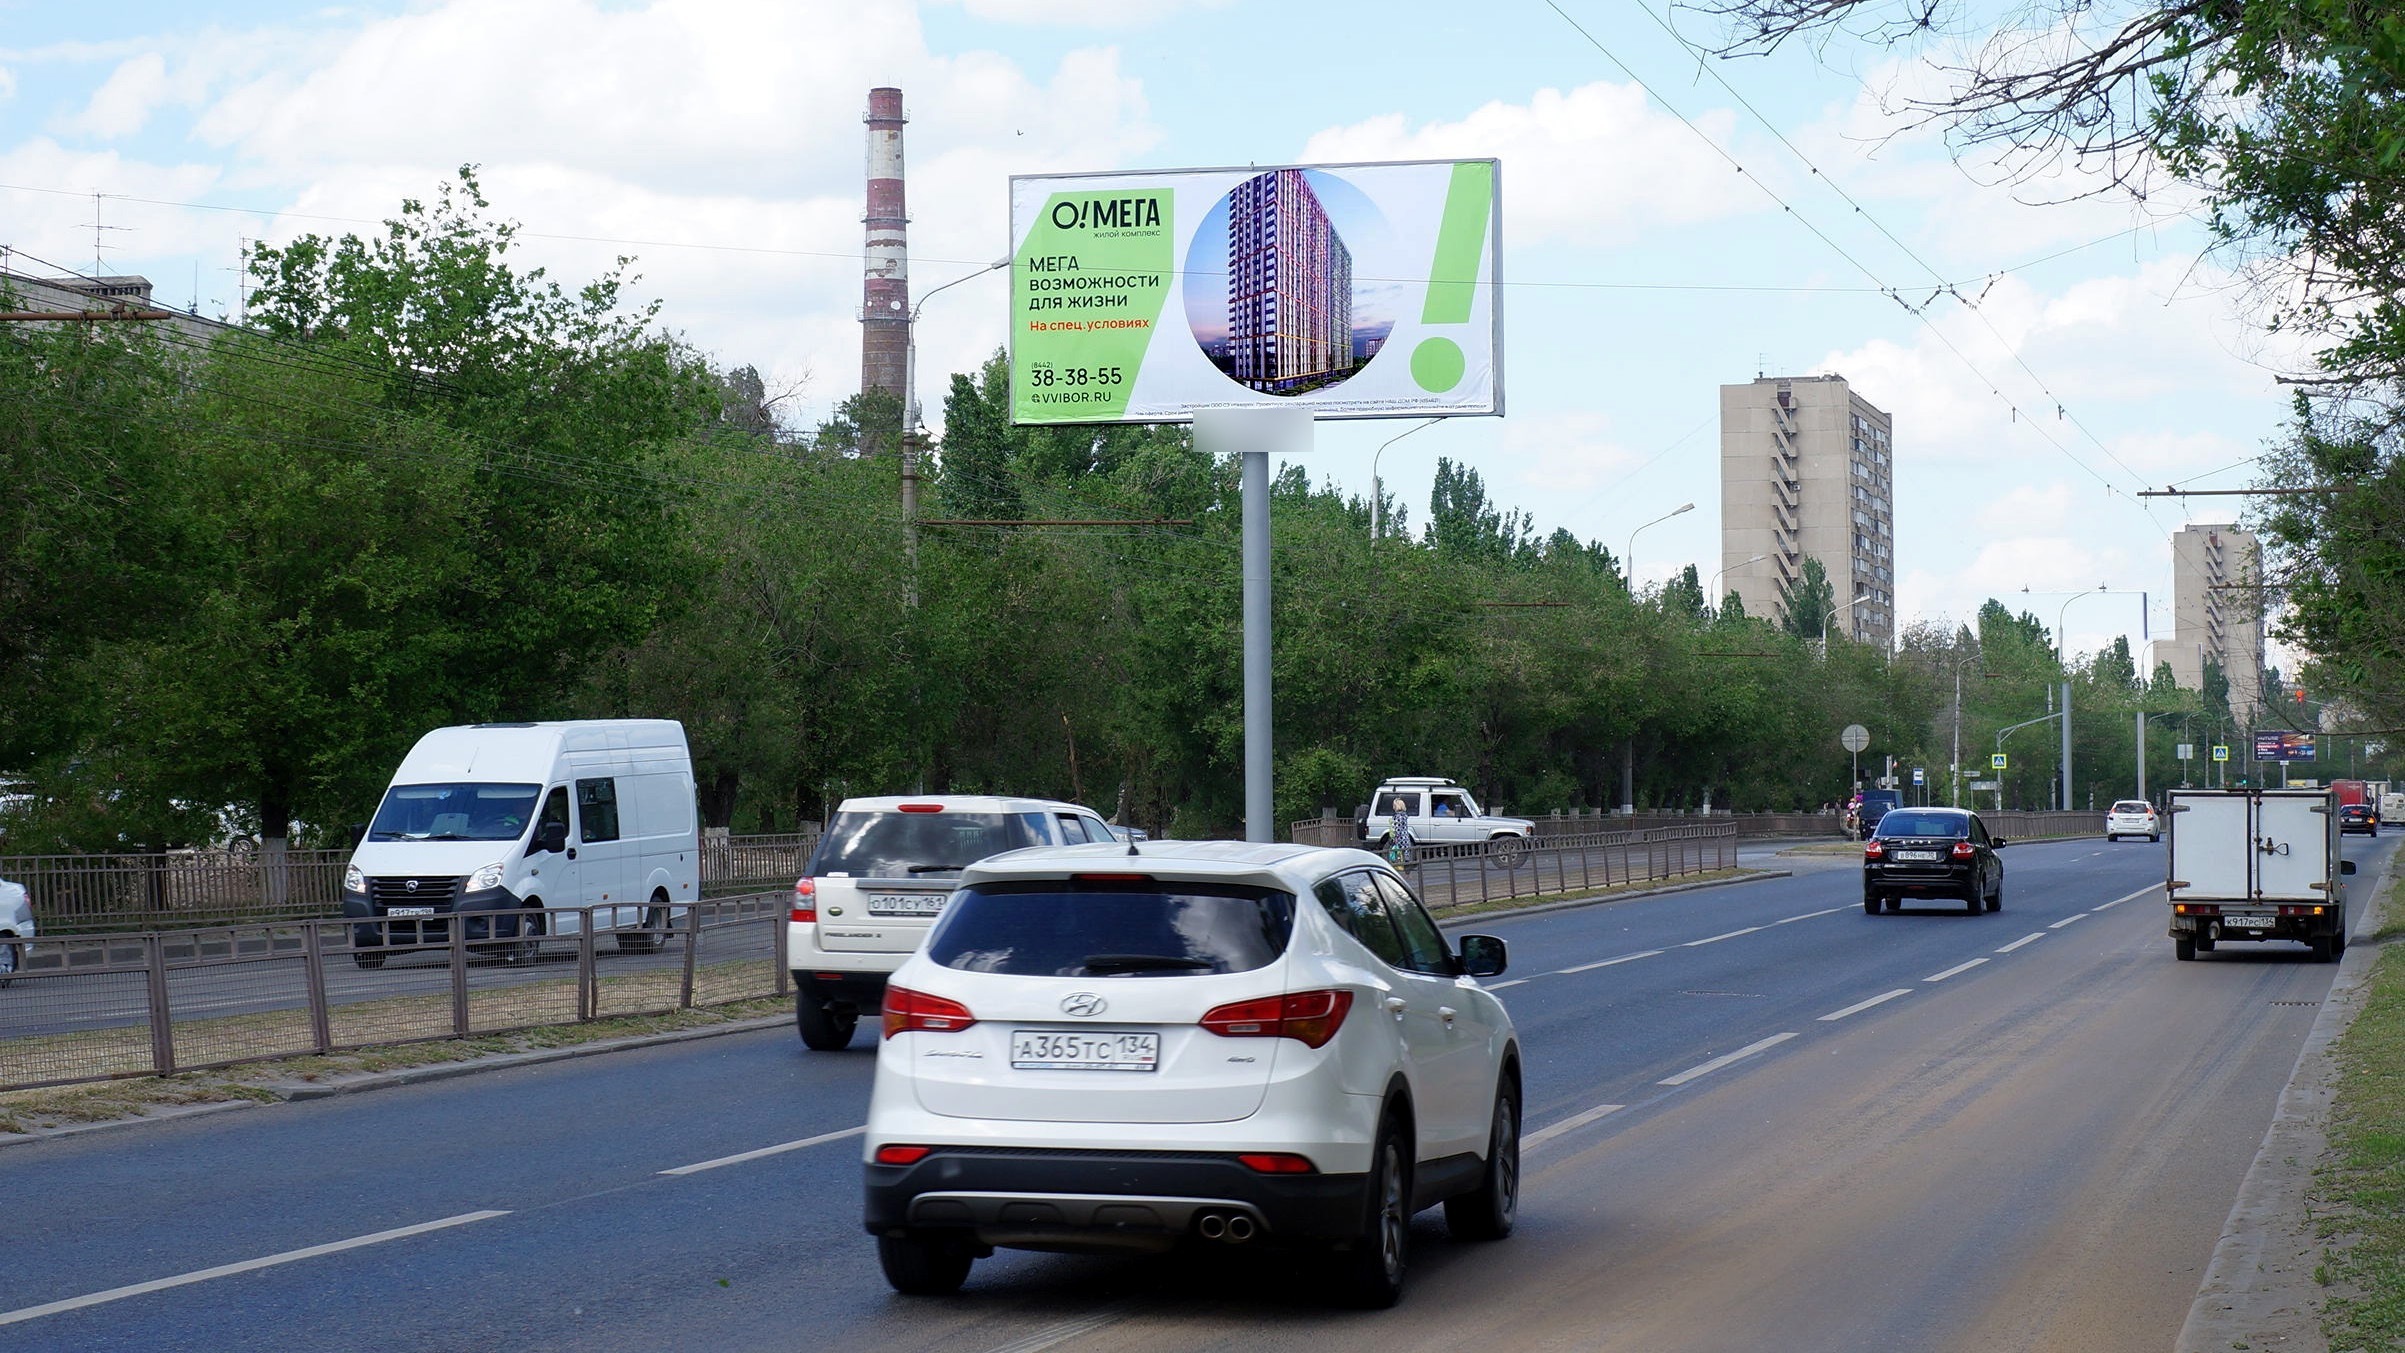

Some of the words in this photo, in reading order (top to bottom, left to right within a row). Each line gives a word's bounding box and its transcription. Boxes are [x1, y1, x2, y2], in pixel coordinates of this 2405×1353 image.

[1030, 256, 1079, 272] МЕГА
[1030, 275, 1159, 291] ВОЗМОЖНОСТИ
[1029, 297, 1062, 311] ДЛЯ
[1068, 295, 1127, 309] ЖИЗНИ
[1030, 320, 1047, 331] На
[1088, 319, 1149, 332] условиях
[1031, 361, 1053, 369] (8442)
[1031, 367, 1122, 387] 38-38-55
[1042, 391, 1111, 403] VVIBOR.RU
[1117, 1035, 1155, 1054] 134
